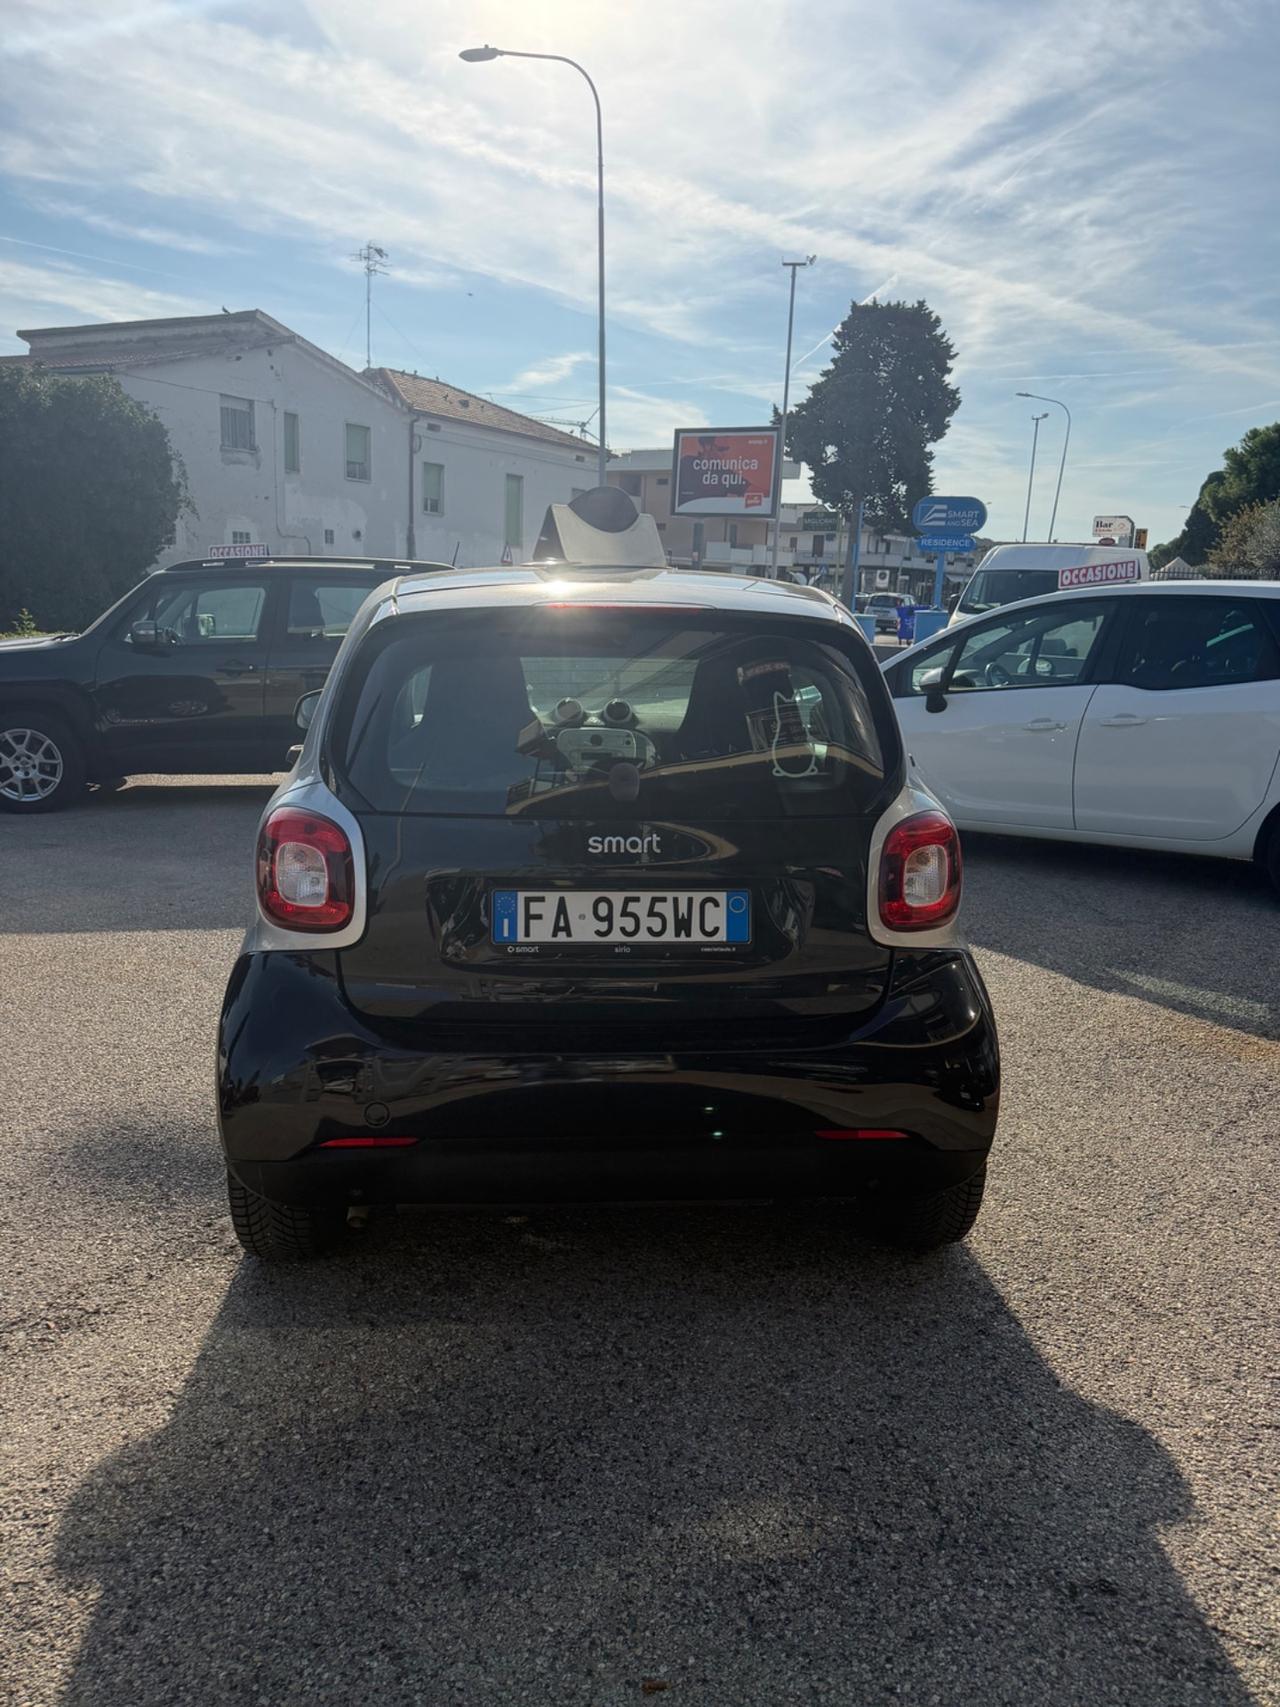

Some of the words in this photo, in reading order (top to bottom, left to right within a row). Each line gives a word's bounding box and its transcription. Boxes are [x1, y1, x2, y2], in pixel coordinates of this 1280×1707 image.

[693, 456, 759, 471] comunica
[702, 472, 718, 485] da
[722, 470, 746, 488] qui.
[947, 511, 980, 519] SMART
[961, 518, 979, 527] SEA
[1096, 520, 1114, 528] Bar
[921, 538, 971, 547] RESIDENCE
[211, 545, 264, 558] OCCASIONE
[1062, 562, 1134, 585] OCCASIONE
[587, 833, 662, 854] smart
[523, 896, 573, 938] FA
[592, 896, 720, 938] 955WC
[515, 945, 539, 954] smart
[614, 945, 631, 953] sirio
